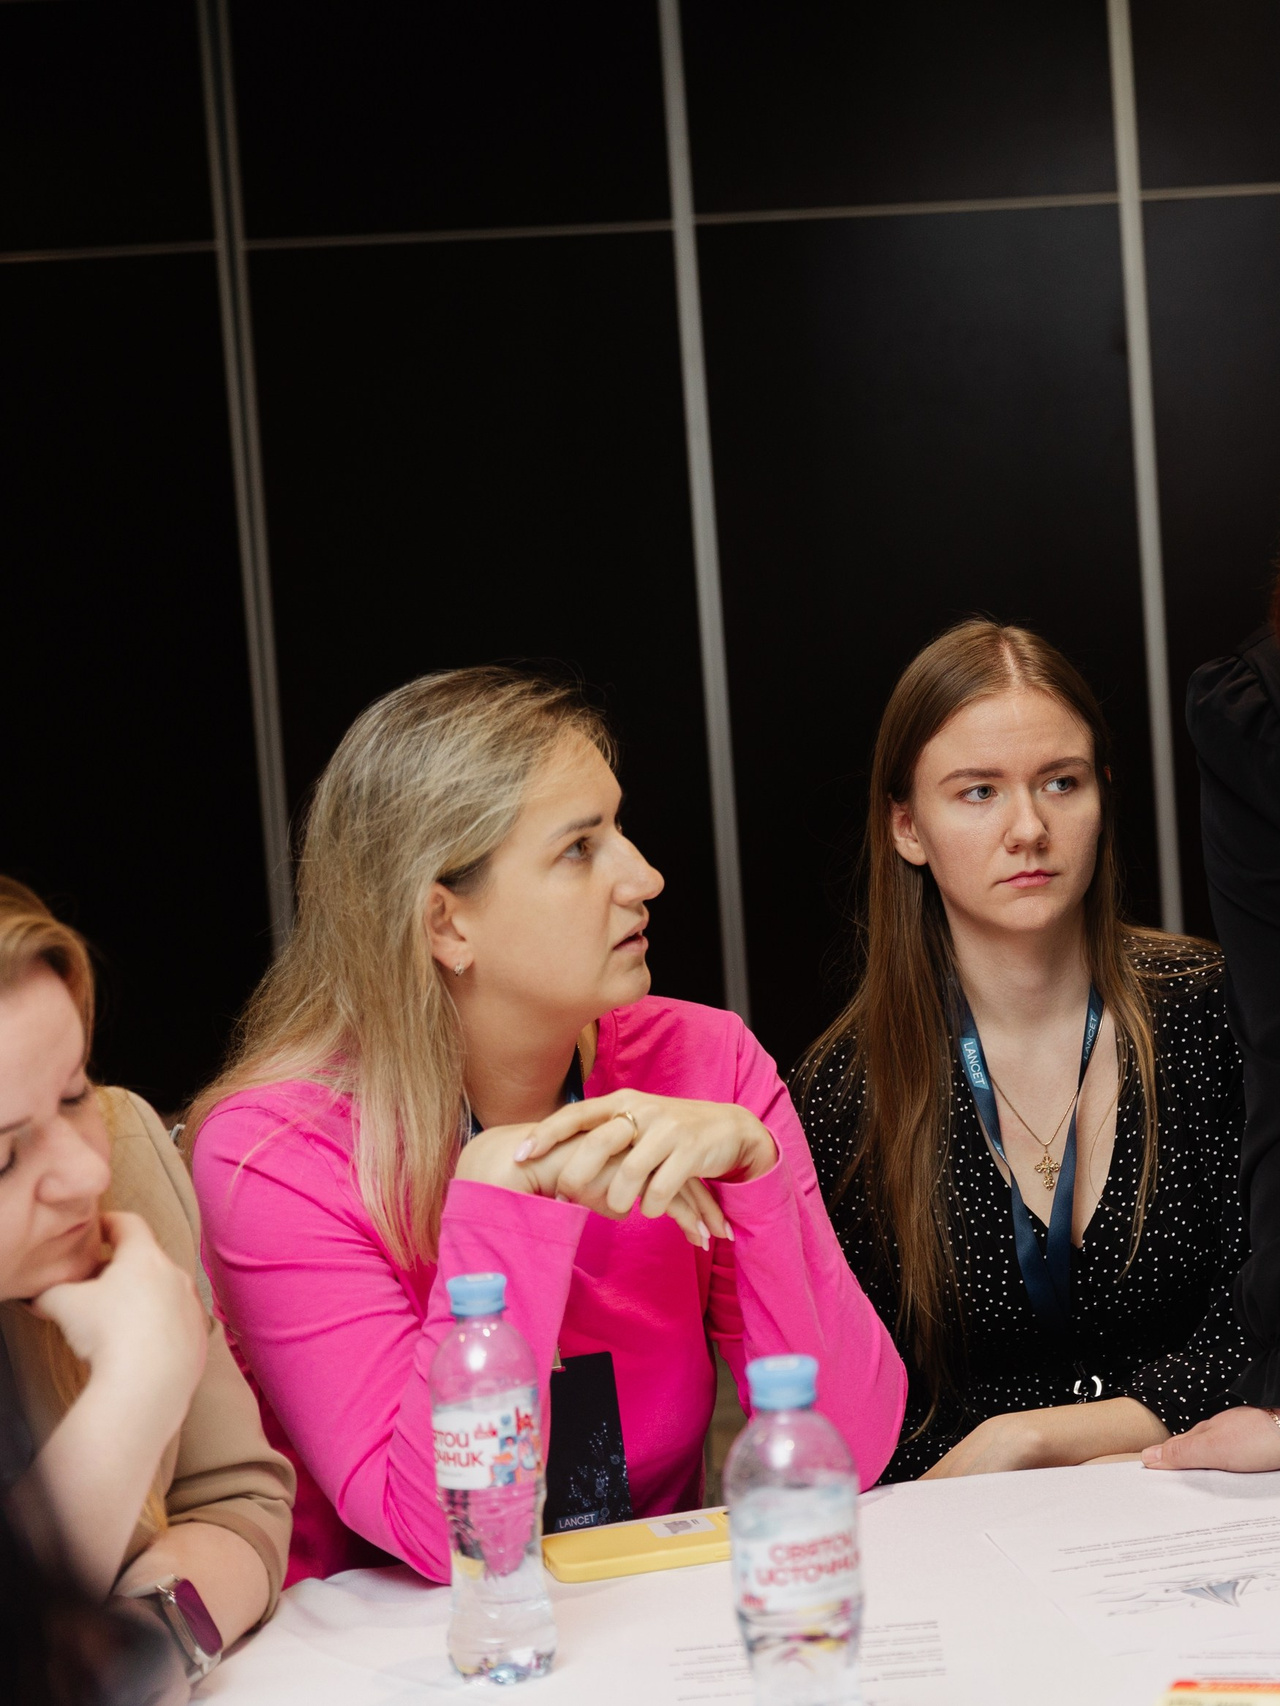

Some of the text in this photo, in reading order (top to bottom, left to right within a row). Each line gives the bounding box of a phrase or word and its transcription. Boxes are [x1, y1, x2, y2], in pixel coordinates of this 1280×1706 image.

[1083, 1014, 1097, 1060] LANCET
[963, 1041, 986, 1086] LANCET
[558, 1513, 596, 1529] LANCET
